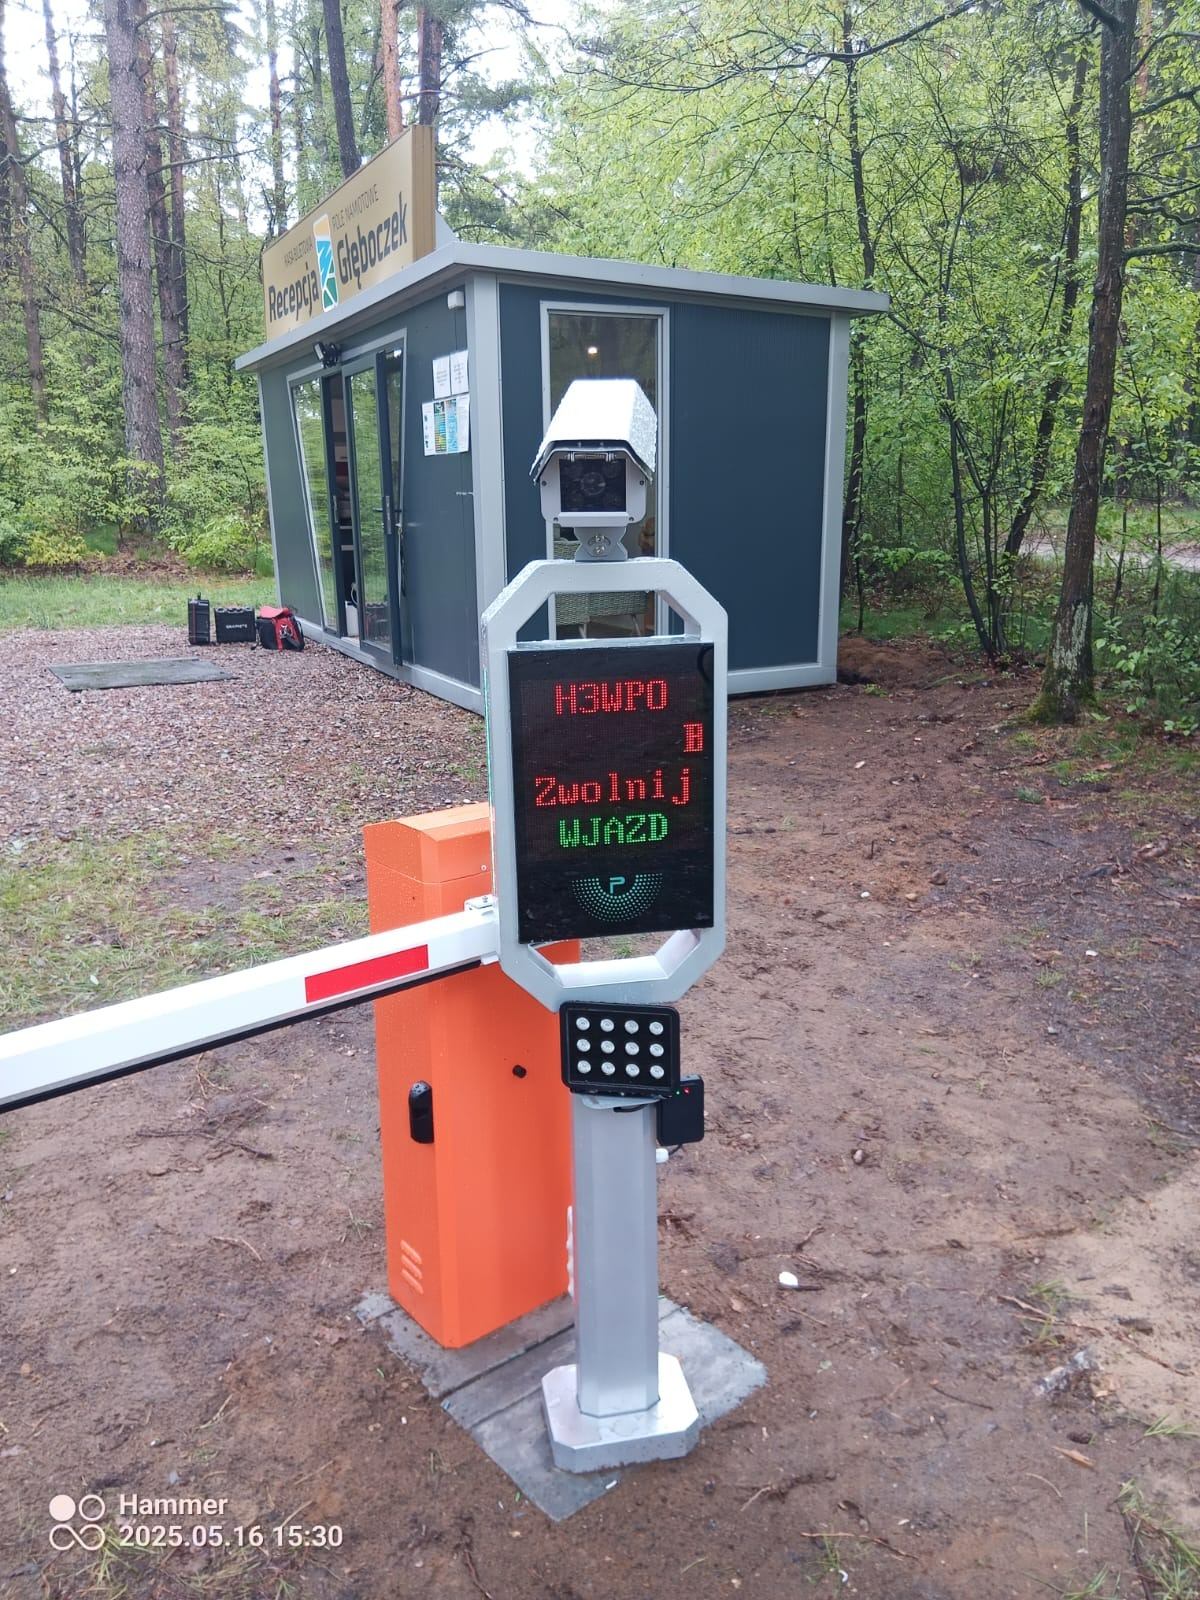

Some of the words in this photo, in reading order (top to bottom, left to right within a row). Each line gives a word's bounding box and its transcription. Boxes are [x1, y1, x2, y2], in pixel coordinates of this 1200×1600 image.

[337, 191, 408, 290] Głęboczek
[268, 261, 320, 323] Recepcja
[535, 768, 691, 806] Zwolnij
[559, 813, 668, 847] WJAZD
